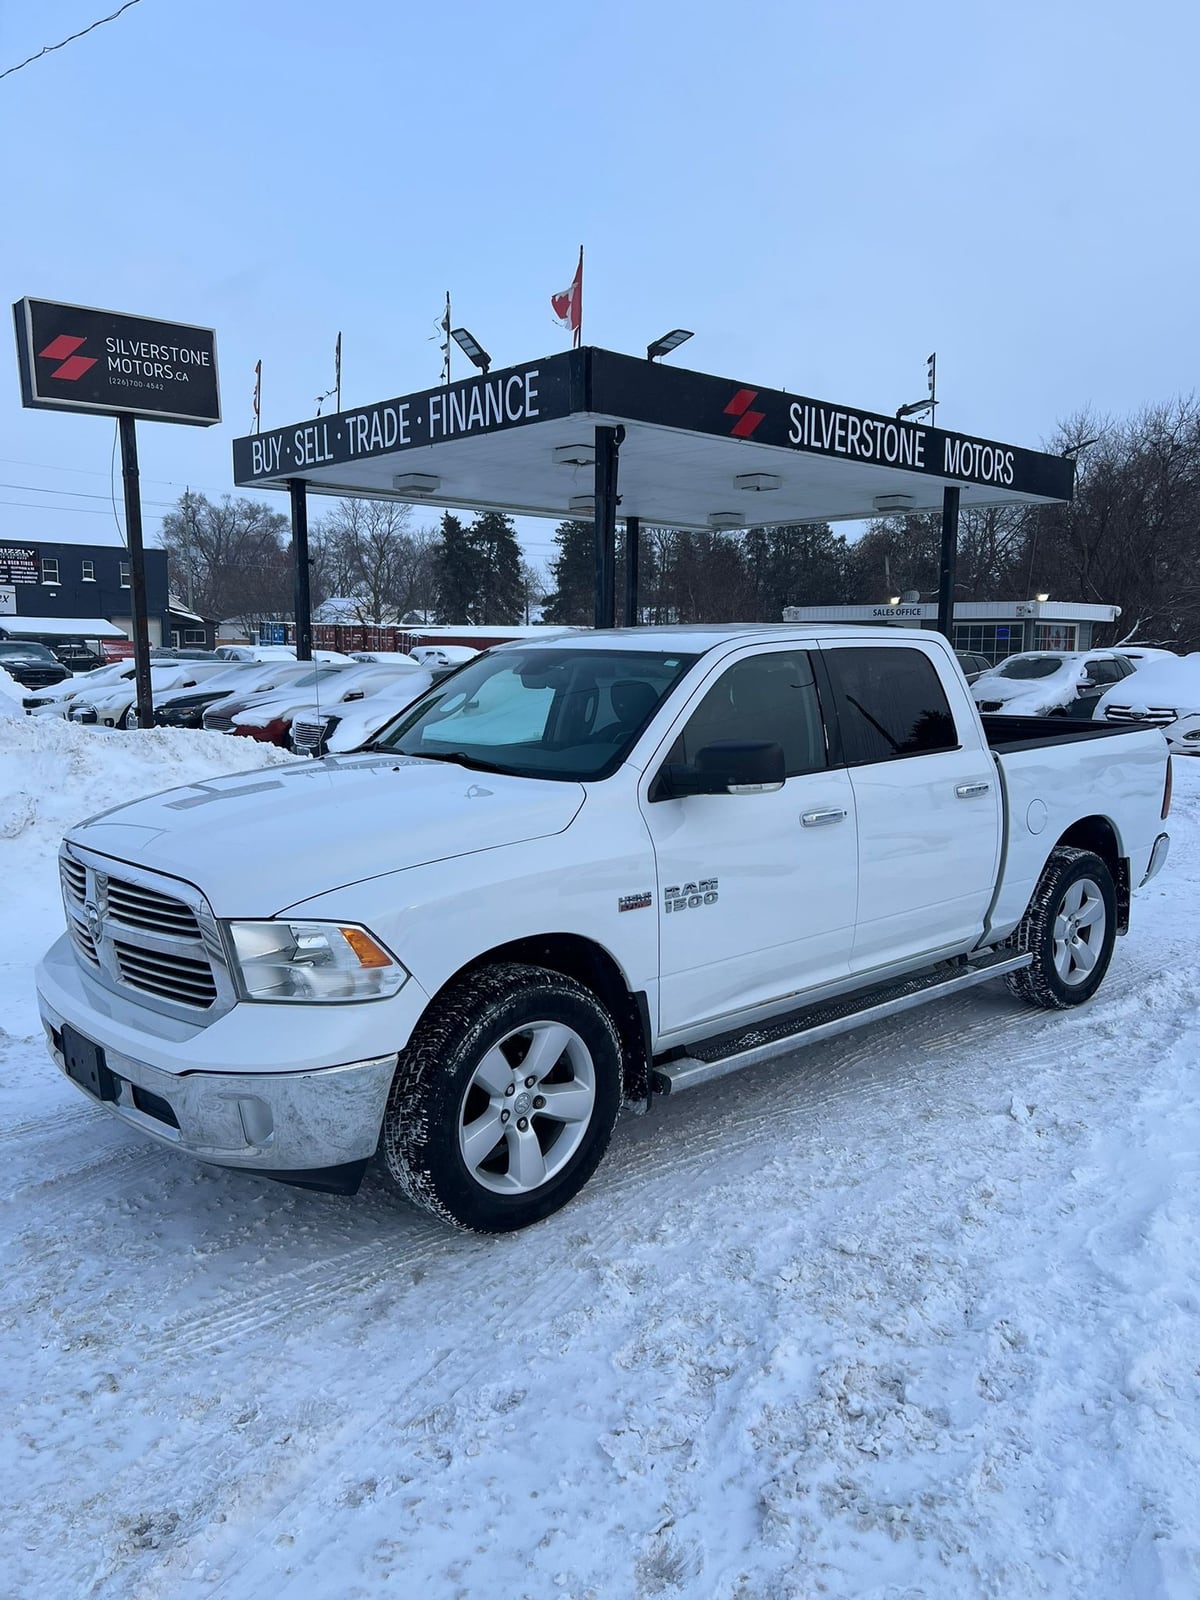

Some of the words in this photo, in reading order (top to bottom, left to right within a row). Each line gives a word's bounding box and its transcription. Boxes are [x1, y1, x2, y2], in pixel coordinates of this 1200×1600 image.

[105, 337, 210, 366] SILVERSTONE
[252, 434, 283, 475] BUY
[294, 423, 334, 466] SELL
[345, 403, 411, 455] TRADE
[429, 370, 540, 439] FINANCE
[788, 402, 926, 468] SILVERSTONE
[944, 437, 1015, 485] MOTORS
[872, 608, 894, 616] SALES
[895, 608, 921, 616] OFFICE
[664, 877, 718, 900] RAM
[664, 891, 718, 914] 1500
